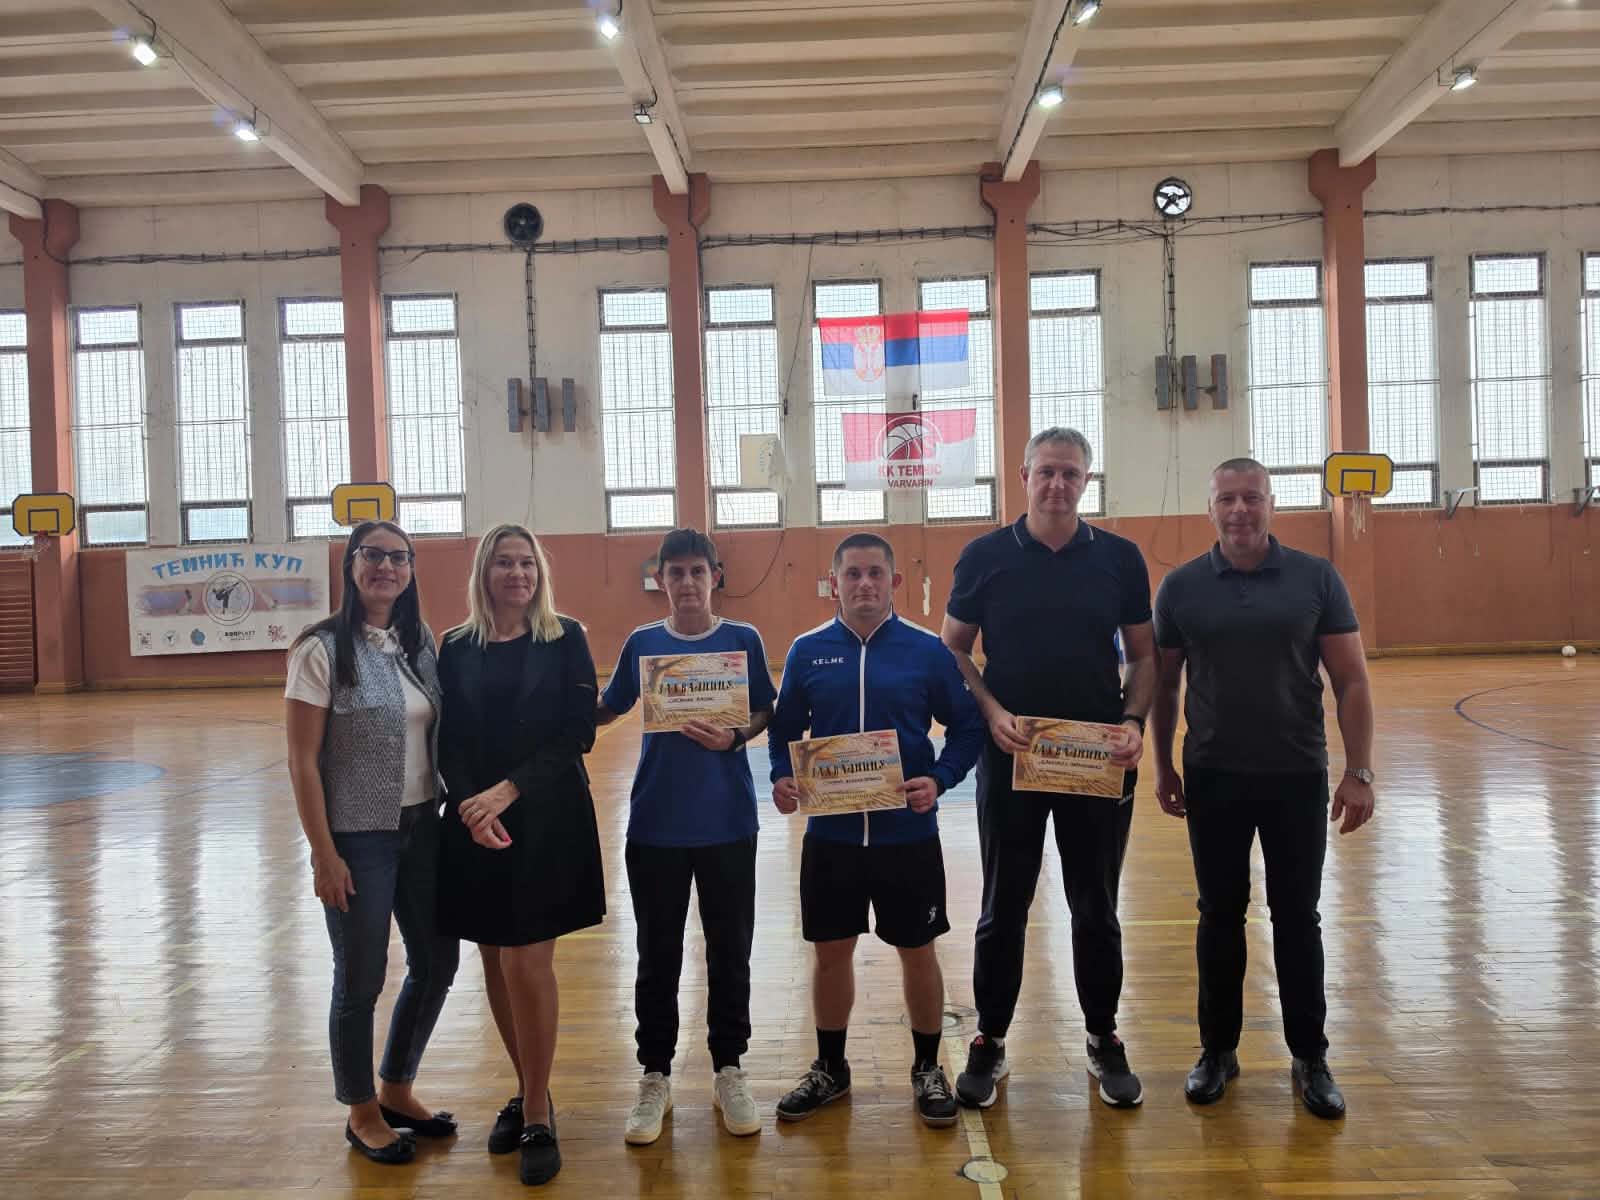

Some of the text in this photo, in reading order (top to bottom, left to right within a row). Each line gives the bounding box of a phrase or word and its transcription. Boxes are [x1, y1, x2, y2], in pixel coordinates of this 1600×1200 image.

[888, 479, 934, 489] VARVARIN
[152, 552, 303, 579] ТЕМНИЋ КУП
[812, 656, 844, 665] KELME
